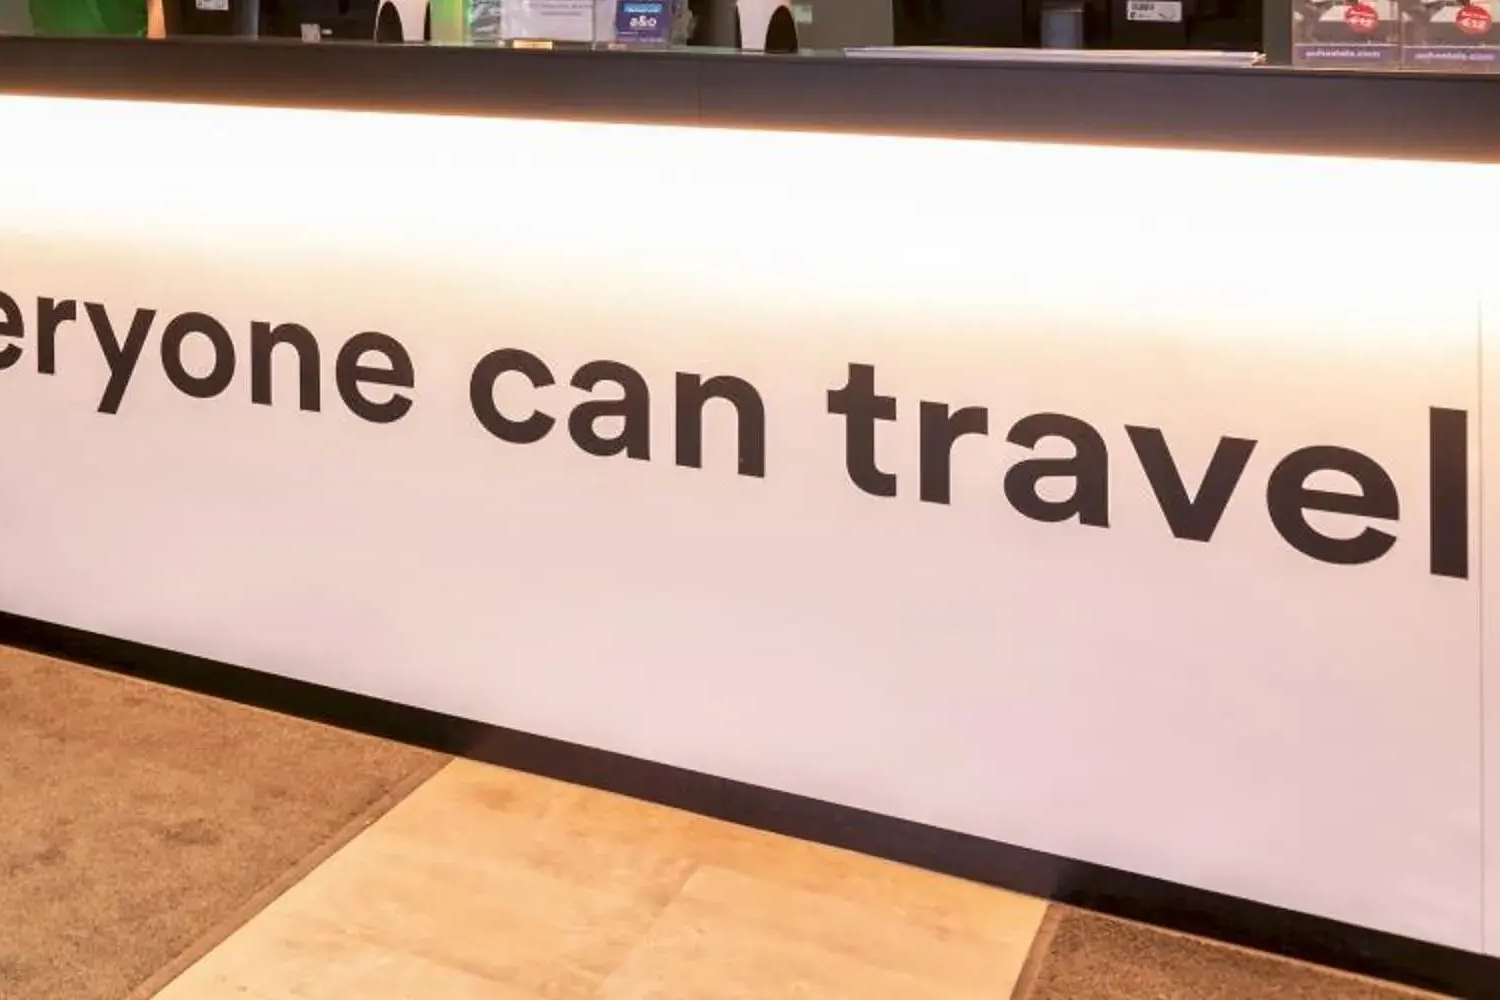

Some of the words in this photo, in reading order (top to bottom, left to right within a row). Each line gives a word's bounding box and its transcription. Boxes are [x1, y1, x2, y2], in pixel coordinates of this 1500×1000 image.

[629, 15, 657, 27] a&o
[470, 349, 764, 478] can
[828, 364, 1468, 579] travel
